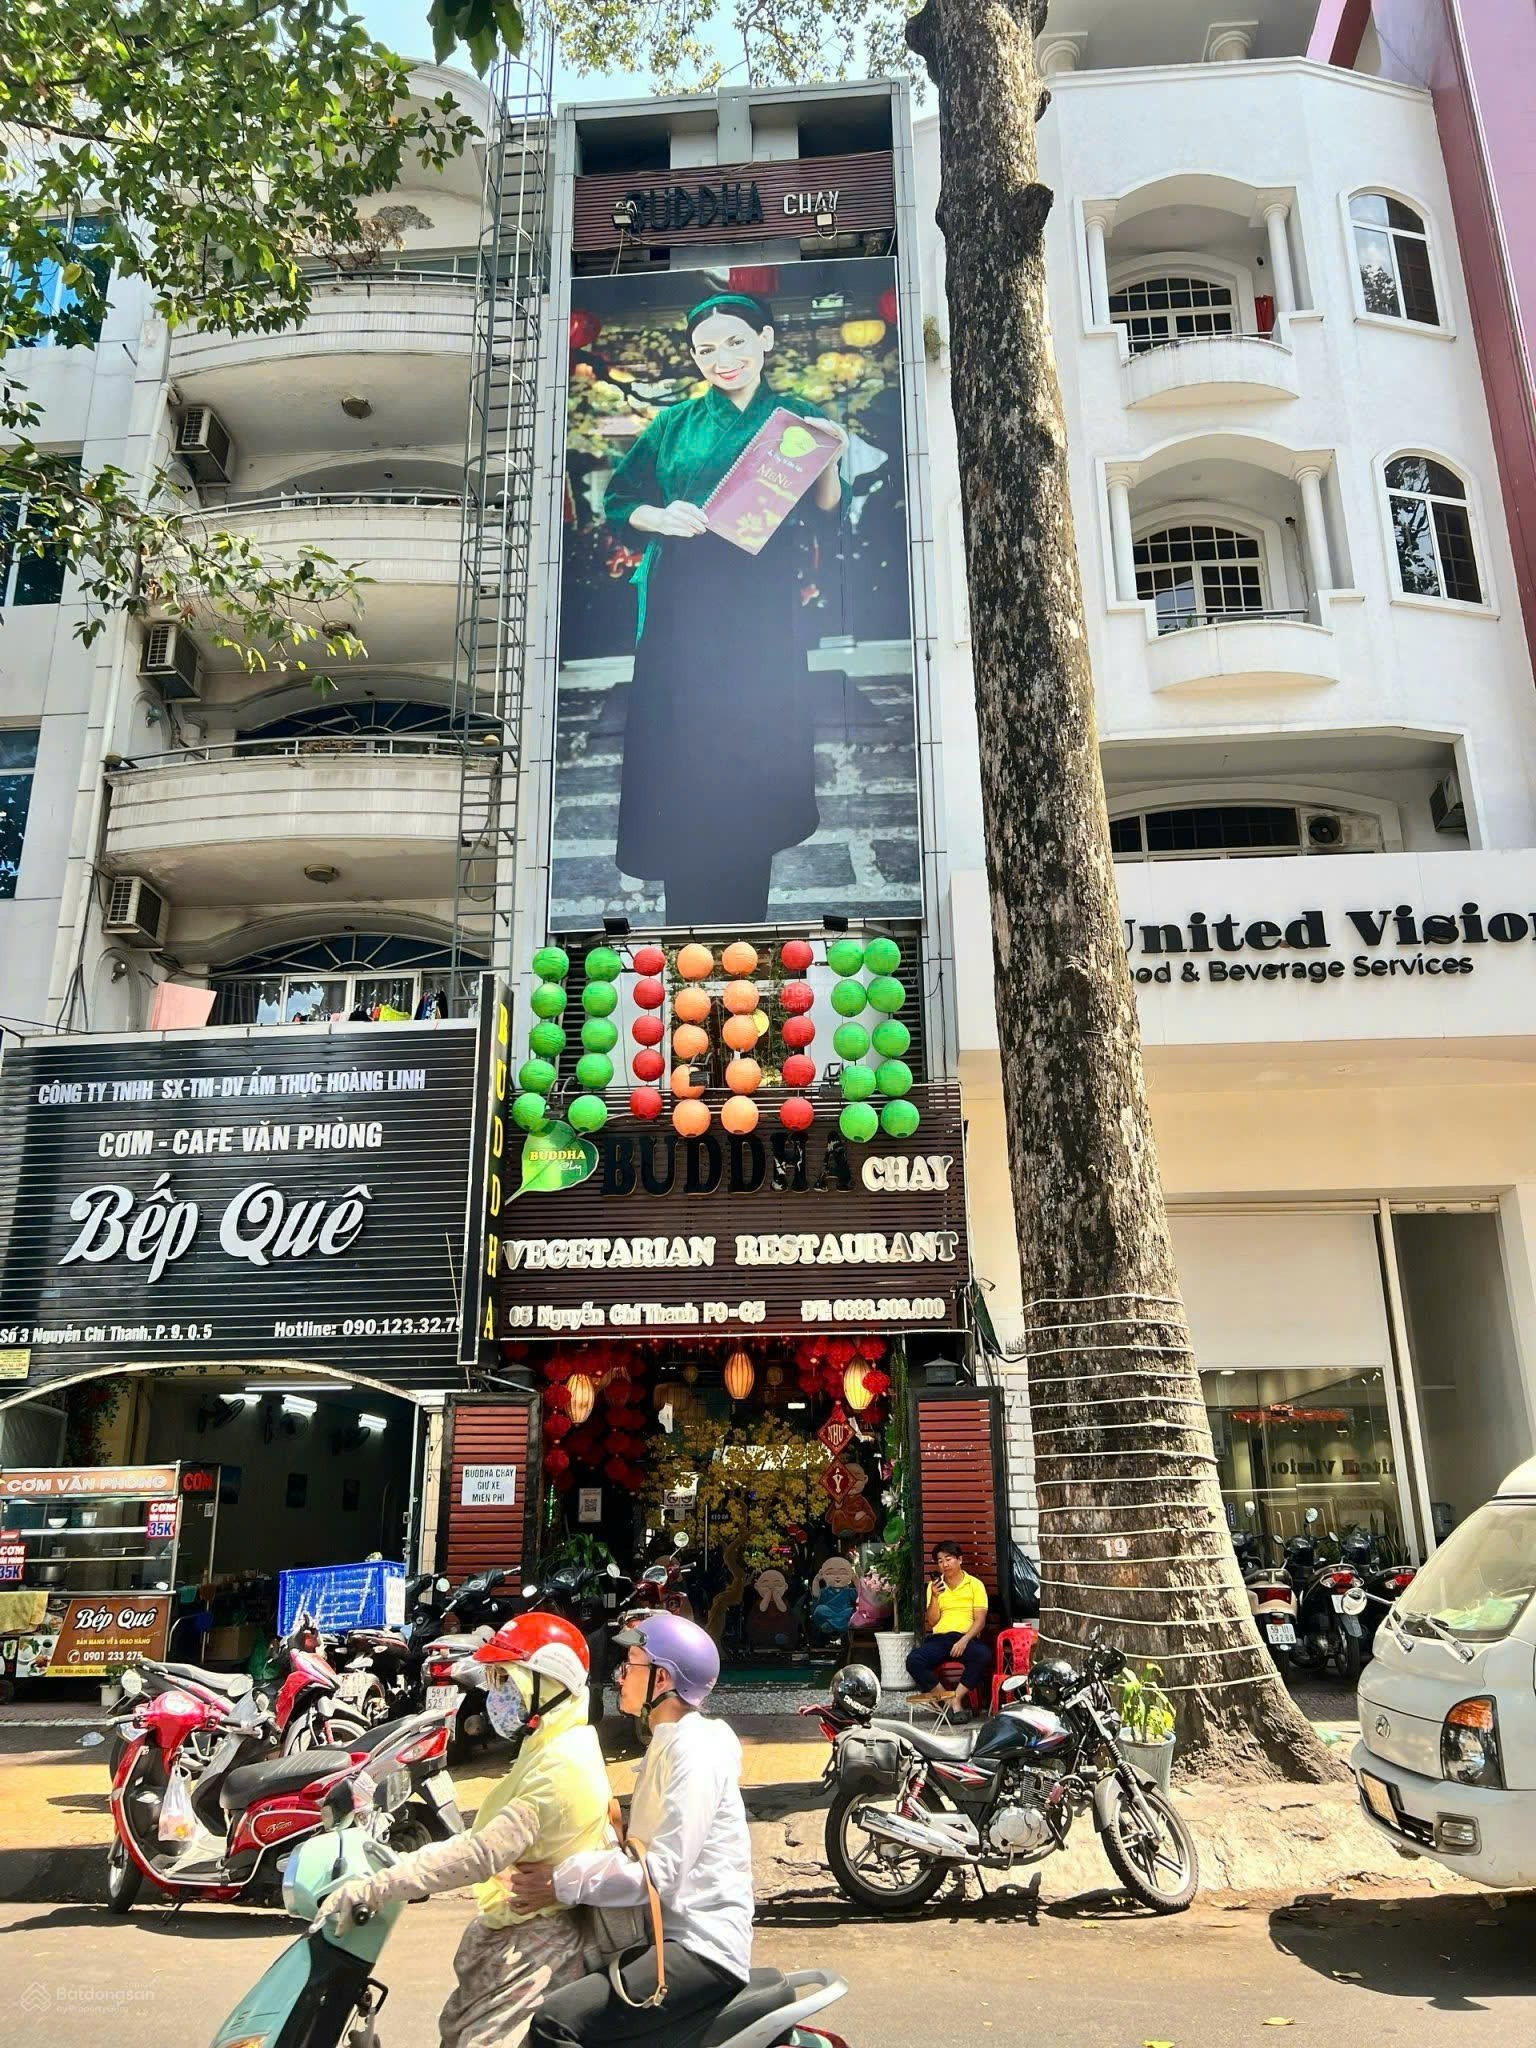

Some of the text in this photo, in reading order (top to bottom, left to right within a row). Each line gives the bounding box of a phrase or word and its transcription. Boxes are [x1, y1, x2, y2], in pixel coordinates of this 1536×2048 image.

[783, 189, 840, 216] CHAY
[1345, 902, 1536, 946] Visio
[1181, 961, 1200, 982] &
[1208, 960, 1345, 983] Beverage
[1353, 953, 1474, 977] Services
[38, 1079, 83, 1104] CÔNG
[87, 1082, 108, 1102] TY
[112, 1080, 154, 1101] TNHH
[247, 1066, 277, 1096] ẨM
[280, 1071, 323, 1098] THỰC
[327, 1067, 384, 1092] HOÀNG
[387, 1069, 426, 1090] LINH
[98, 1130, 154, 1157] CƠM
[172, 1127, 235, 1155] CAFE
[242, 1120, 296, 1152] VĂN
[297, 1117, 384, 1149] PHÒNG
[530, 1150, 587, 1160] BUDDHA
[599, 1131, 955, 1197] BUDDHA CHAY
[57, 1172, 373, 1284] Bếp Quê
[503, 1230, 960, 1270] VEGETARIAN RESTAURANT
[537, 1301, 606, 1331] Nguyễn
[609, 1303, 642, 1326] Chí
[642, 1303, 699, 1325] Thanh
[0, 1326, 18, 1343] Số
[20, 1328, 29, 1343] 3
[33, 1324, 81, 1344] Nguyễn
[85, 1325, 105, 1342] Chí
[110, 1326, 152, 1341] Thanh,
[274, 1320, 337, 1337] Hotline:
[7, 1475, 168, 1492] CƠM VĂN PHÒNG
[465, 1469, 514, 1478] BUDDHA CHAY
[491, 1481, 501, 1490] XE
[150, 1522, 172, 1536] 35K
[75, 1606, 158, 1632] Bếp Quê
[83, 1651, 143, 1660] 0901 233 275
